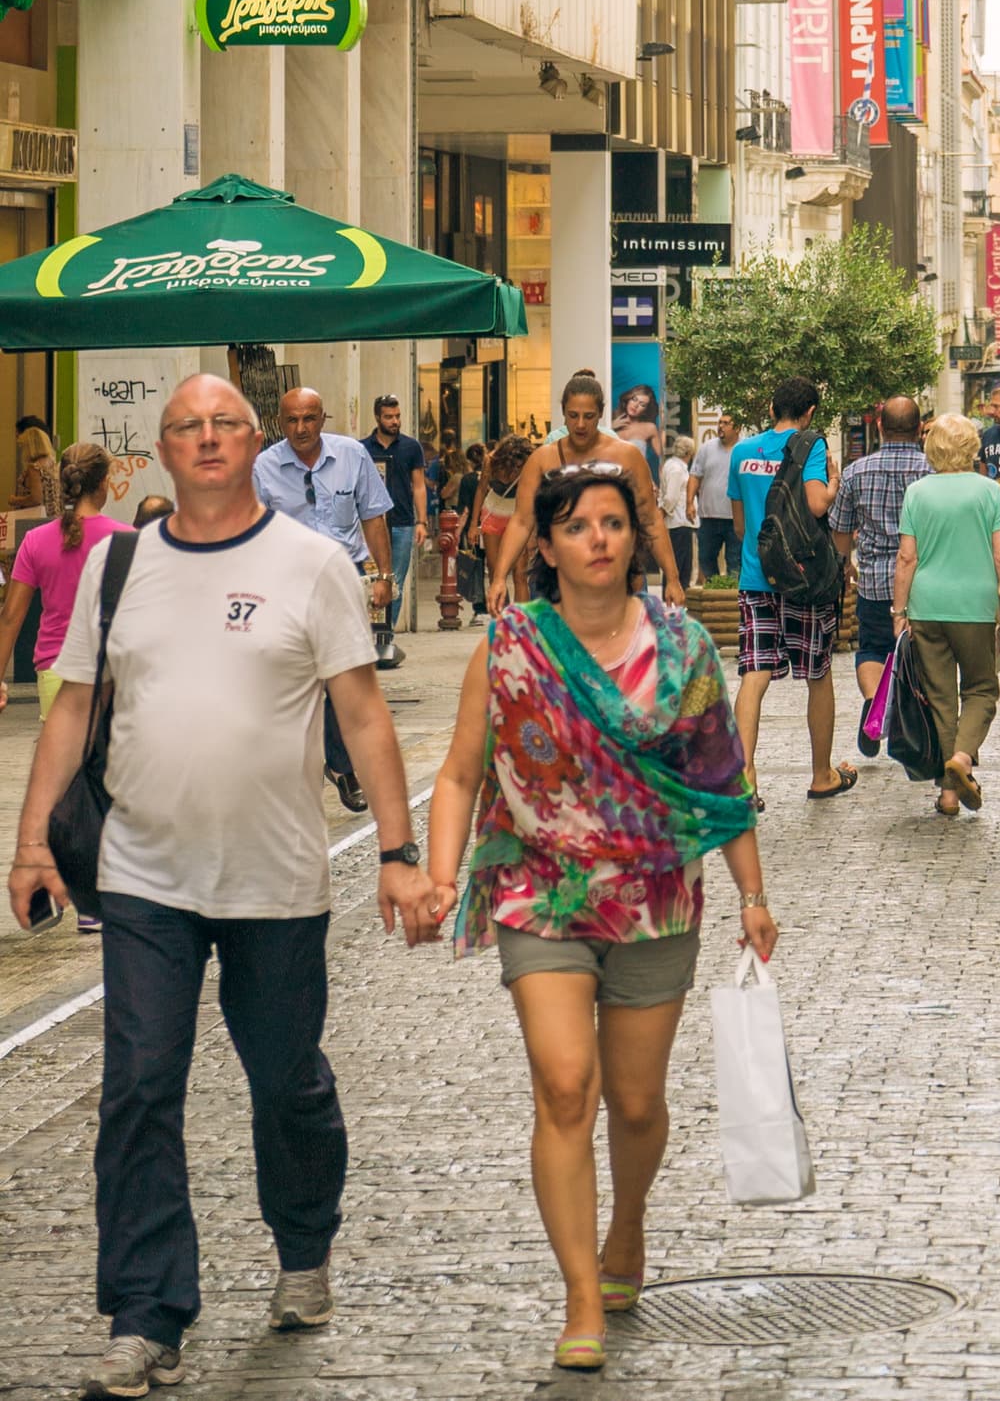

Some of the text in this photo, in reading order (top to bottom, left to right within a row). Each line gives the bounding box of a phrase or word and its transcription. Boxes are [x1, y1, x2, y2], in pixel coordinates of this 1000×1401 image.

[259, 23, 328, 37] μικρογεύματα
[623, 238, 725, 251] intimissimi
[166, 277, 311, 290] μικρογεύματα
[227, 601, 257, 622] 37
